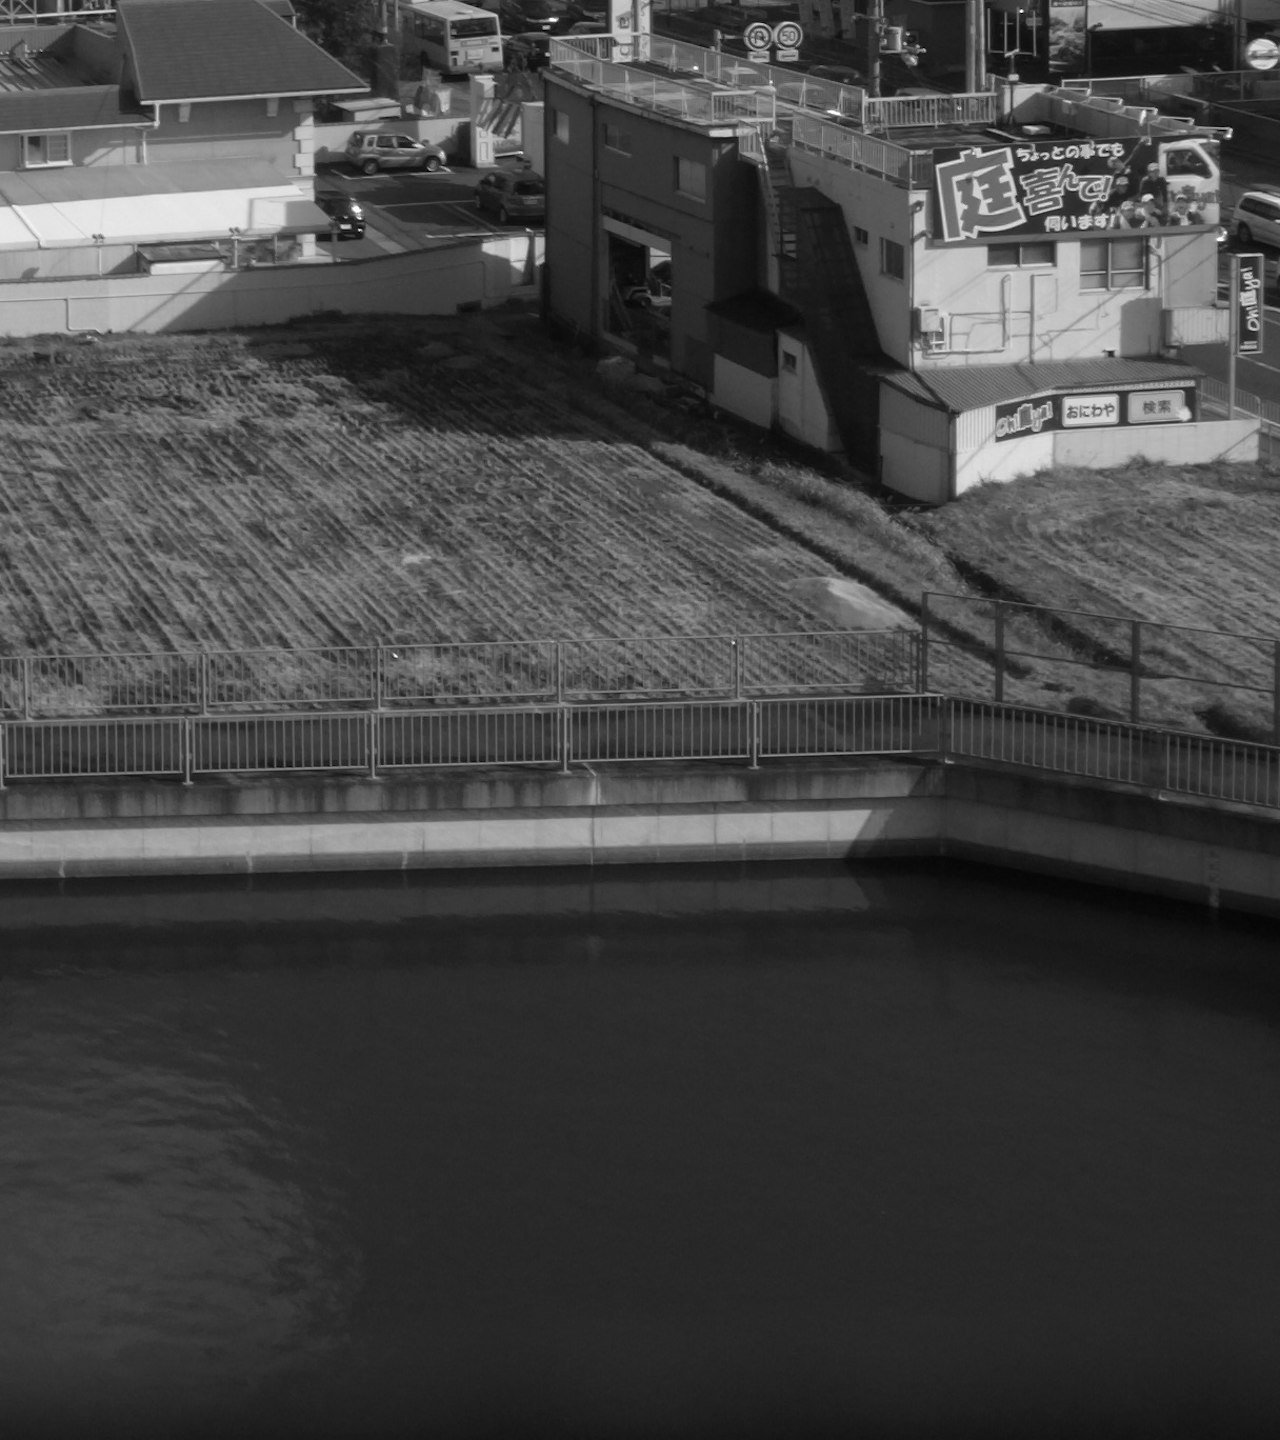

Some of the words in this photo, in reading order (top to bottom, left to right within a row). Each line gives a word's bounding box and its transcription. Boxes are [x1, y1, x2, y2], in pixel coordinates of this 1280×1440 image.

[782, 30, 796, 42] 50
[935, 146, 1028, 242] 庭
[1066, 403, 1116, 419] おにわや
[1143, 399, 1172, 415] 検索
